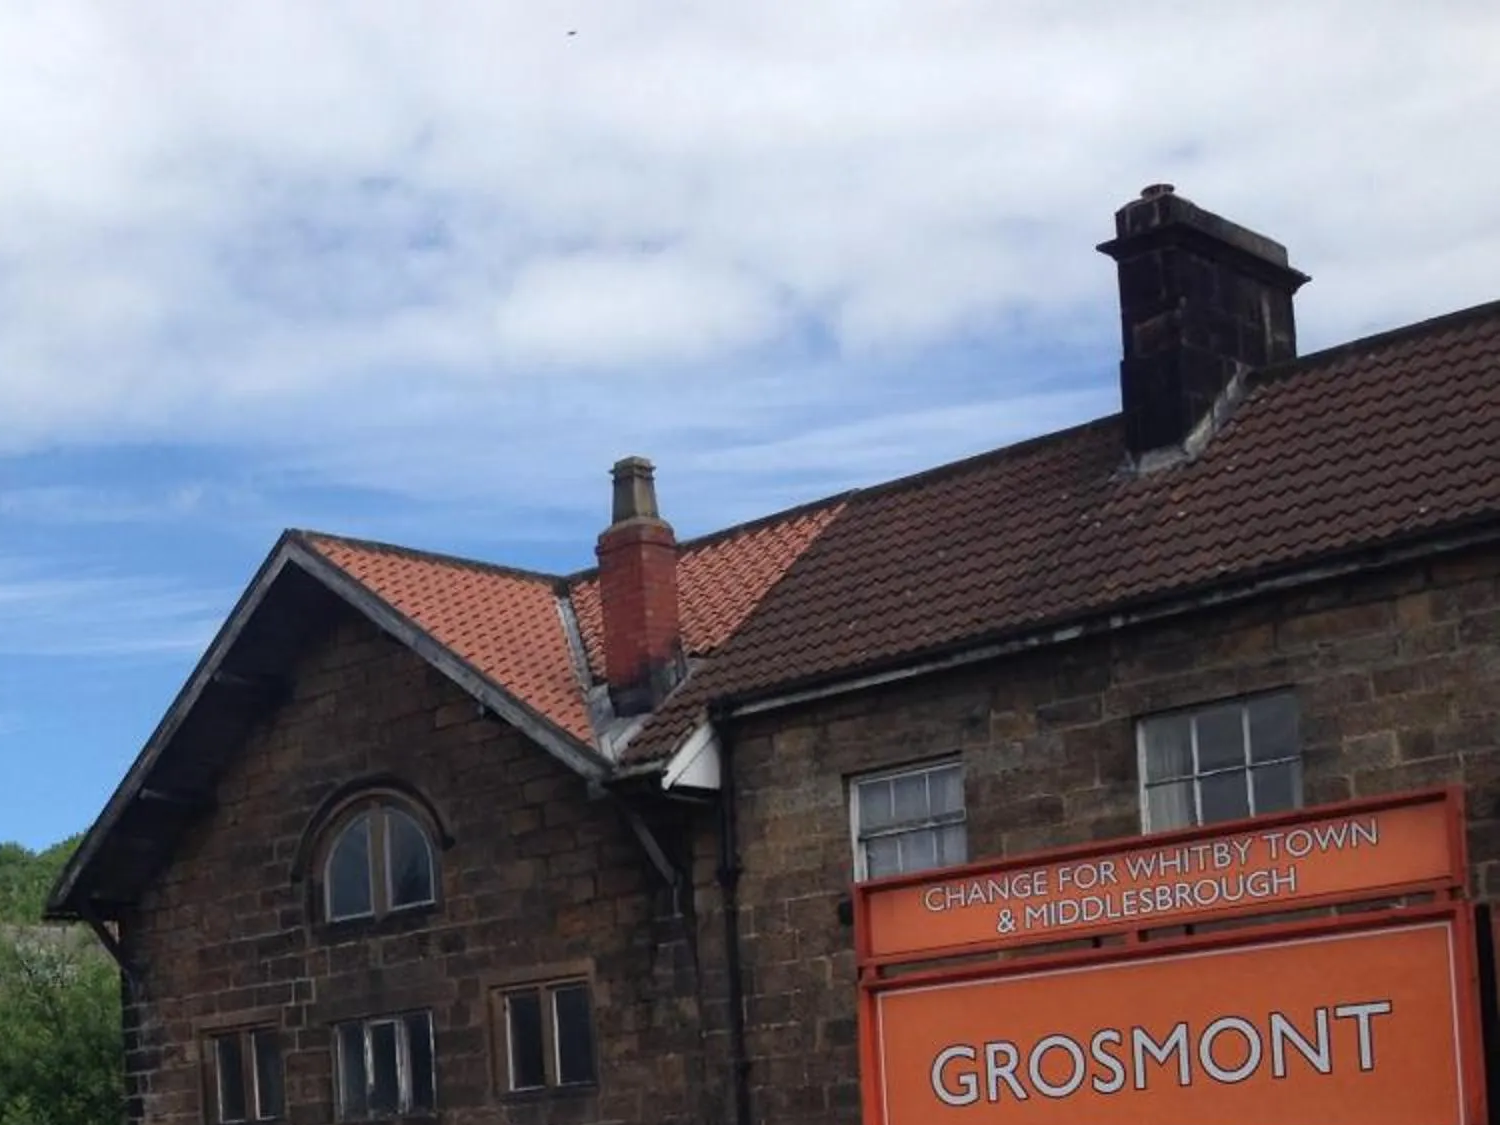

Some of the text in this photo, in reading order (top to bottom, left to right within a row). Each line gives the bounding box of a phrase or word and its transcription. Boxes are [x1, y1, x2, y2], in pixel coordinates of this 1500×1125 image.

[925, 818, 1378, 912] CHANGE FOR WHITBY TOWN
[996, 867, 1297, 933] & MIDDLESBROUGH
[931, 1001, 1393, 1106] GROSMONT
